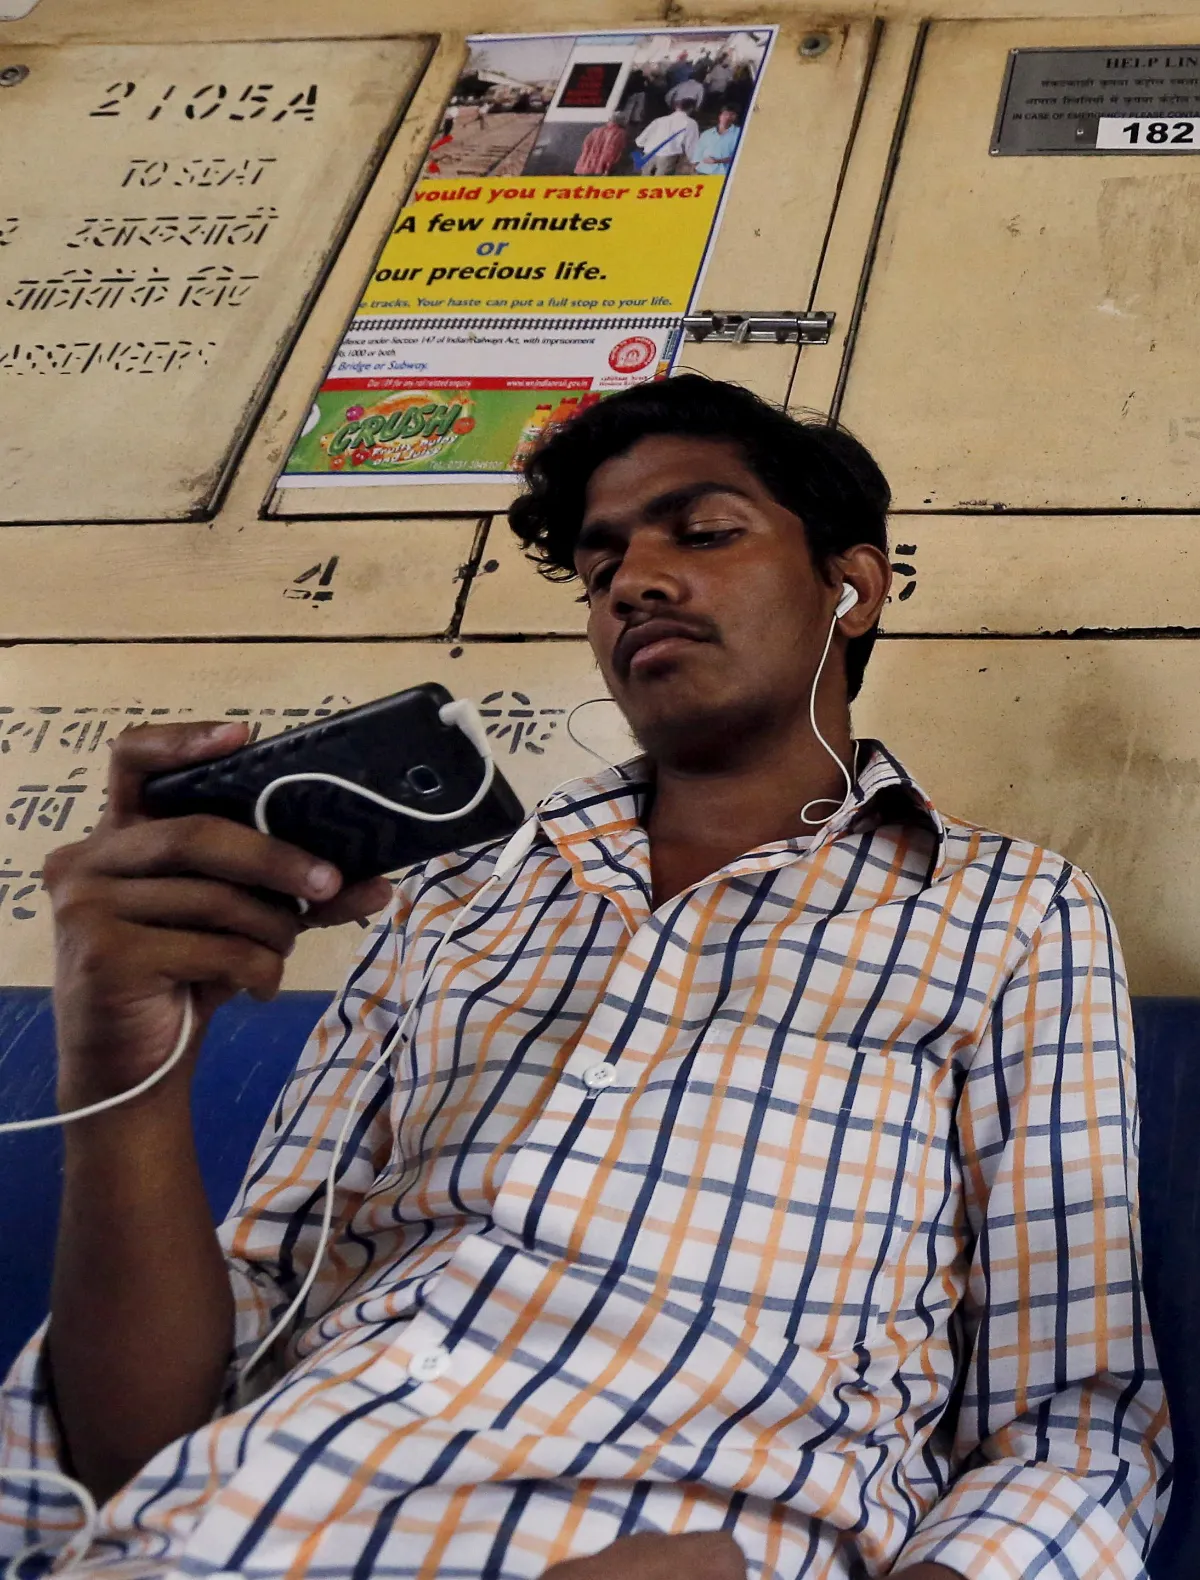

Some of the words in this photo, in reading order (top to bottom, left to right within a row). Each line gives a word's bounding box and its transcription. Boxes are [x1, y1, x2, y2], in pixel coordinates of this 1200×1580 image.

[1105, 57, 1159, 69] HELP
[89, 82, 317, 122] 2105A
[1122, 122, 1195, 144] 182
[121, 159, 168, 188] TO
[174, 158, 277, 187] SEAT
[487, 186, 537, 204] you
[544, 185, 629, 199] rather
[636, 184, 704, 199] save?
[393, 216, 415, 233] A
[427, 213, 484, 232] few
[492, 212, 612, 232] minutes
[476, 241, 509, 256] or
[375, 267, 423, 282] our
[426, 263, 545, 286] precious
[554, 261, 607, 280] life.
[370, 299, 410, 308] tracks.
[417, 298, 444, 307] Your
[447, 298, 481, 307] haste
[510, 299, 533, 308] put
[536, 299, 544, 307] a
[548, 297, 567, 307] full
[571, 299, 599, 308] stop
[602, 299, 615, 307] to
[618, 299, 647, 308] your
[650, 296, 672, 306] life.
[368, 337, 388, 345] under
[391, 336, 418, 345] Section
[421, 336, 436, 344] 147
[338, 361, 371, 372] Bridge
[327, 404, 462, 456] CRUSH
[283, 556, 339, 608] 4
